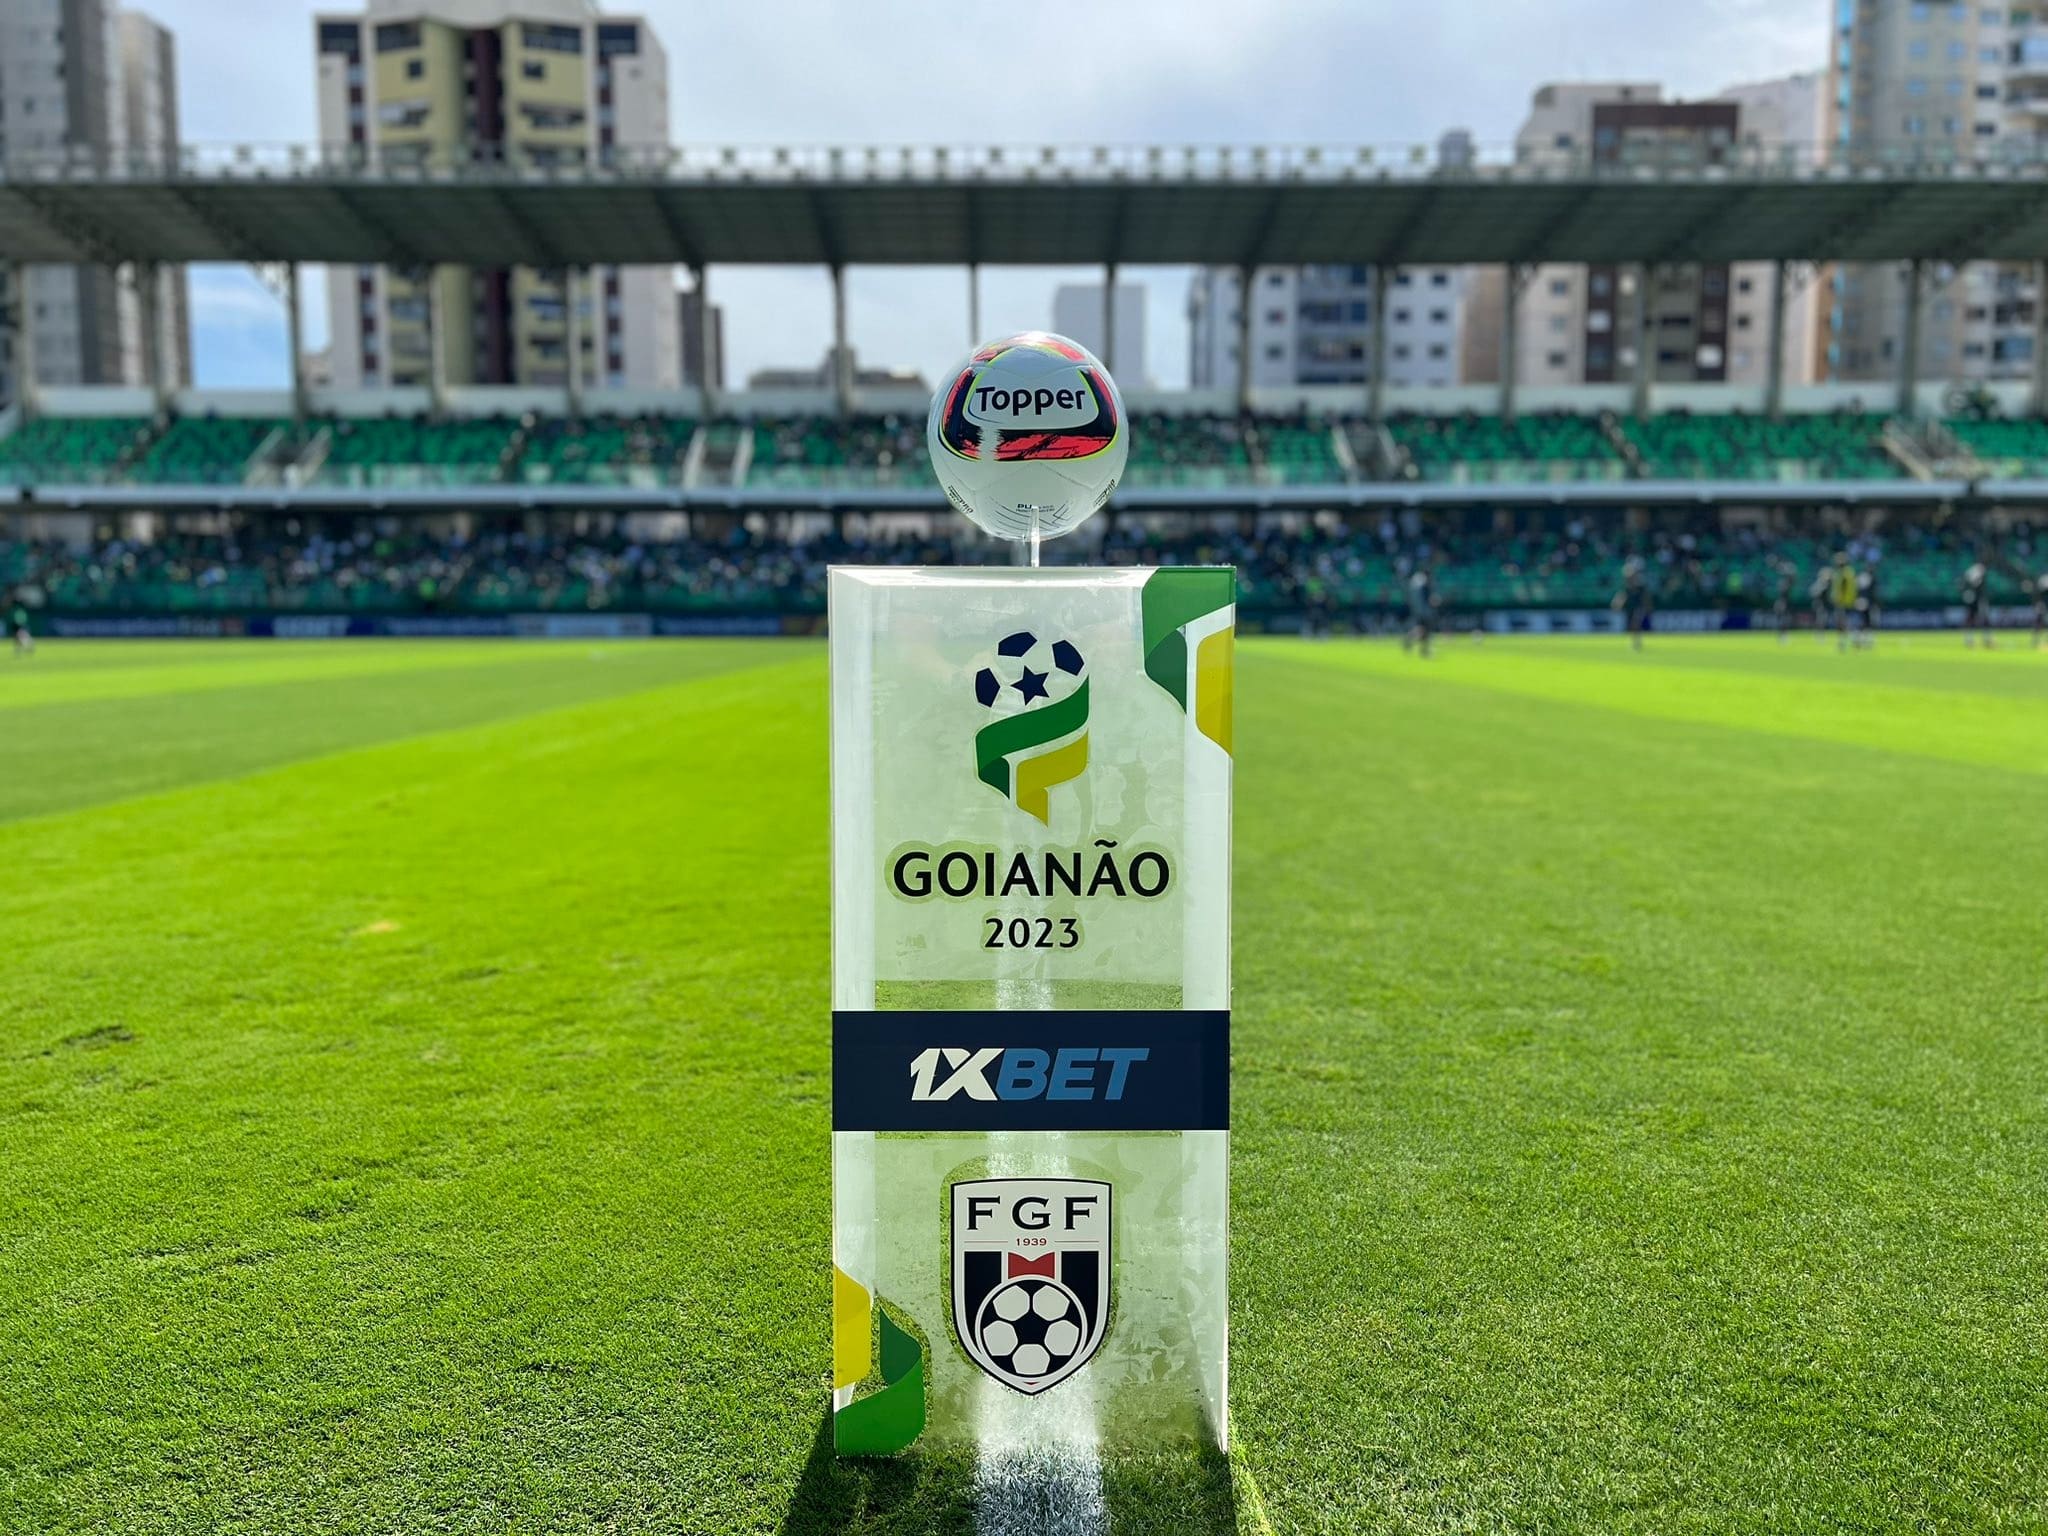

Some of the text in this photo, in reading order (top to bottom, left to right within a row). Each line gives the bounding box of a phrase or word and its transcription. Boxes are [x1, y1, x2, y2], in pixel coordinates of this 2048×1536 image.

[975, 386, 1085, 416] Topper
[893, 840, 1170, 898] GOIANÃO
[985, 918, 1079, 949] 2023
[909, 1047, 1150, 1101] 1XBET
[967, 1195, 1098, 1231] FGF
[1016, 1237, 1047, 1246] 1939
